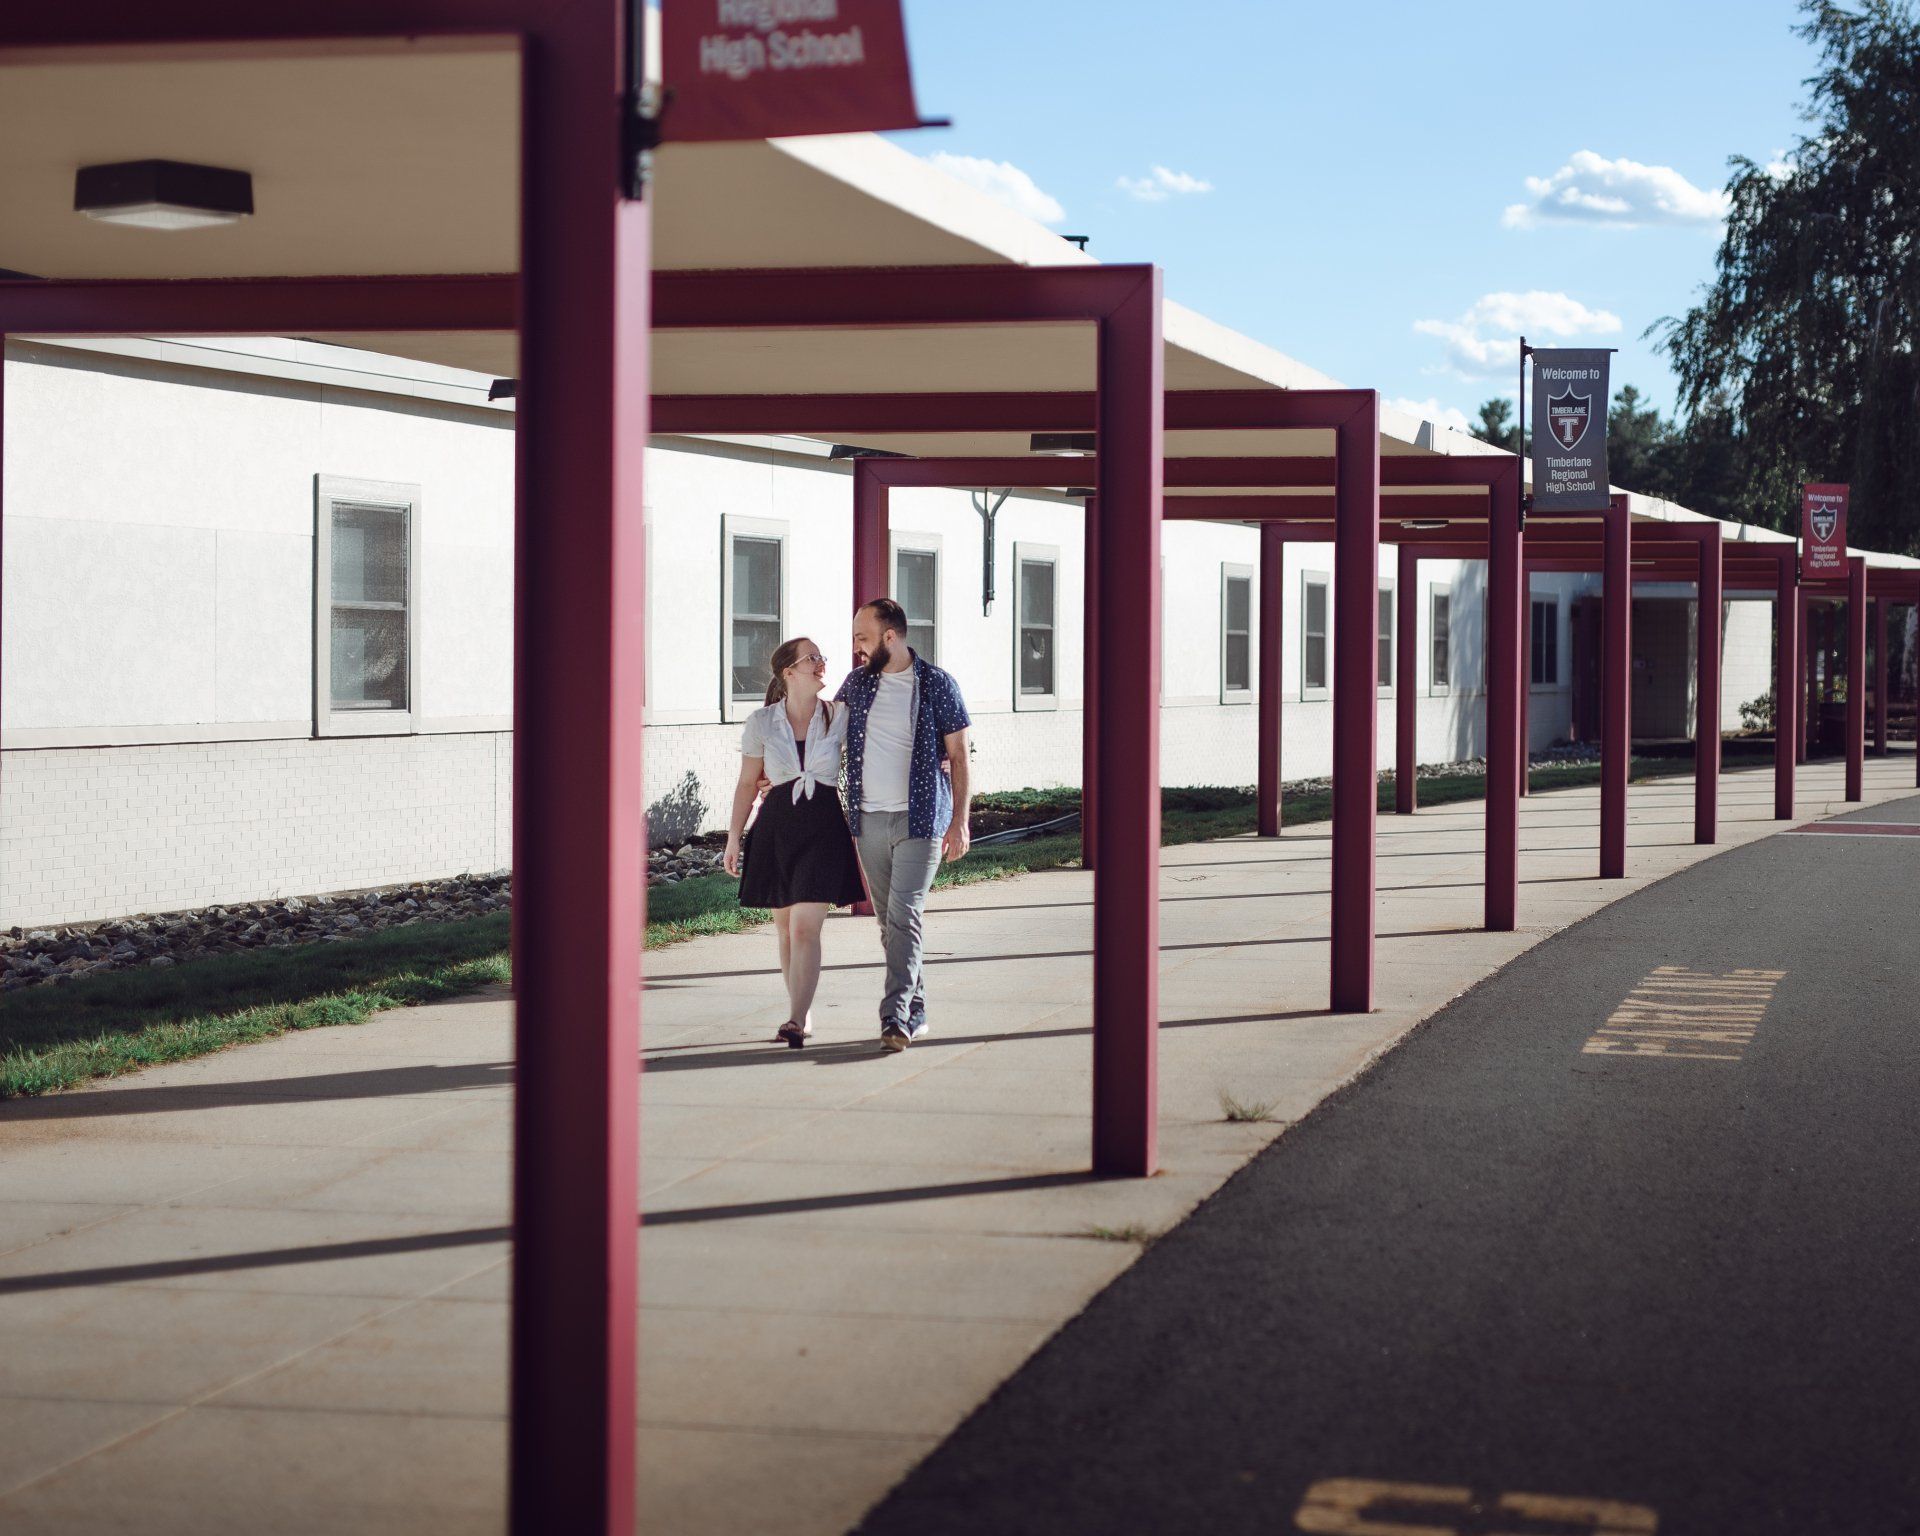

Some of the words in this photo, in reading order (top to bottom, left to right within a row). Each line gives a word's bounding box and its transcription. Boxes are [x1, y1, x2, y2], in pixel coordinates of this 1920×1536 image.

[700, 35, 765, 79] High
[768, 26, 864, 69] School
[1542, 367, 1587, 380] Welcome
[1589, 368, 1600, 380] to
[1551, 407, 1586, 415] TIMBERLANE
[1558, 417, 1579, 442] T
[1546, 457, 1592, 468] Timberlane
[1551, 469, 1588, 482] Regional
[1545, 481, 1565, 494] High
[1566, 480, 1596, 492] School
[1808, 494, 1836, 503] Welcome
[1836, 495, 1843, 503] to
[1818, 524, 1829, 537] T
[1810, 559, 1822, 568] High
